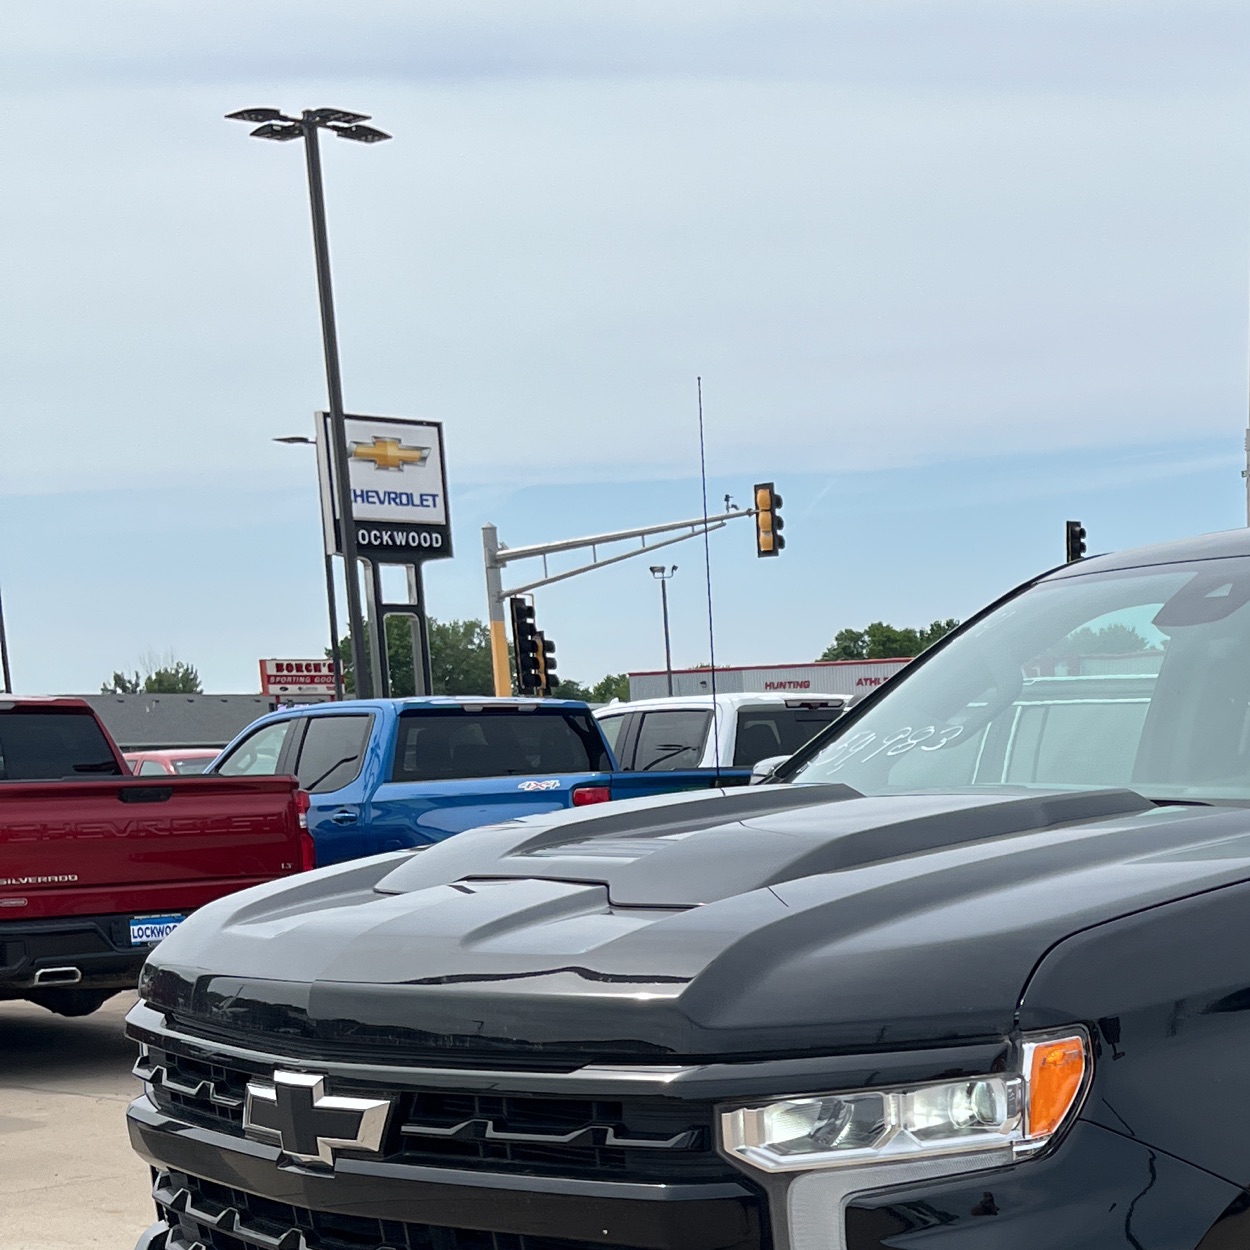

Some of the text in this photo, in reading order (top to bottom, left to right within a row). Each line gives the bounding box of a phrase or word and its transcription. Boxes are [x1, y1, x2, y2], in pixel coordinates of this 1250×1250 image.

[350, 488, 439, 508] HEVROLET
[357, 529, 442, 548] OCKWOOD
[764, 680, 811, 690] HUNTING
[855, 676, 889, 687] ATHL
[0, 874, 79, 886] SILVERADO
[131, 924, 179, 939] LOCKWO
